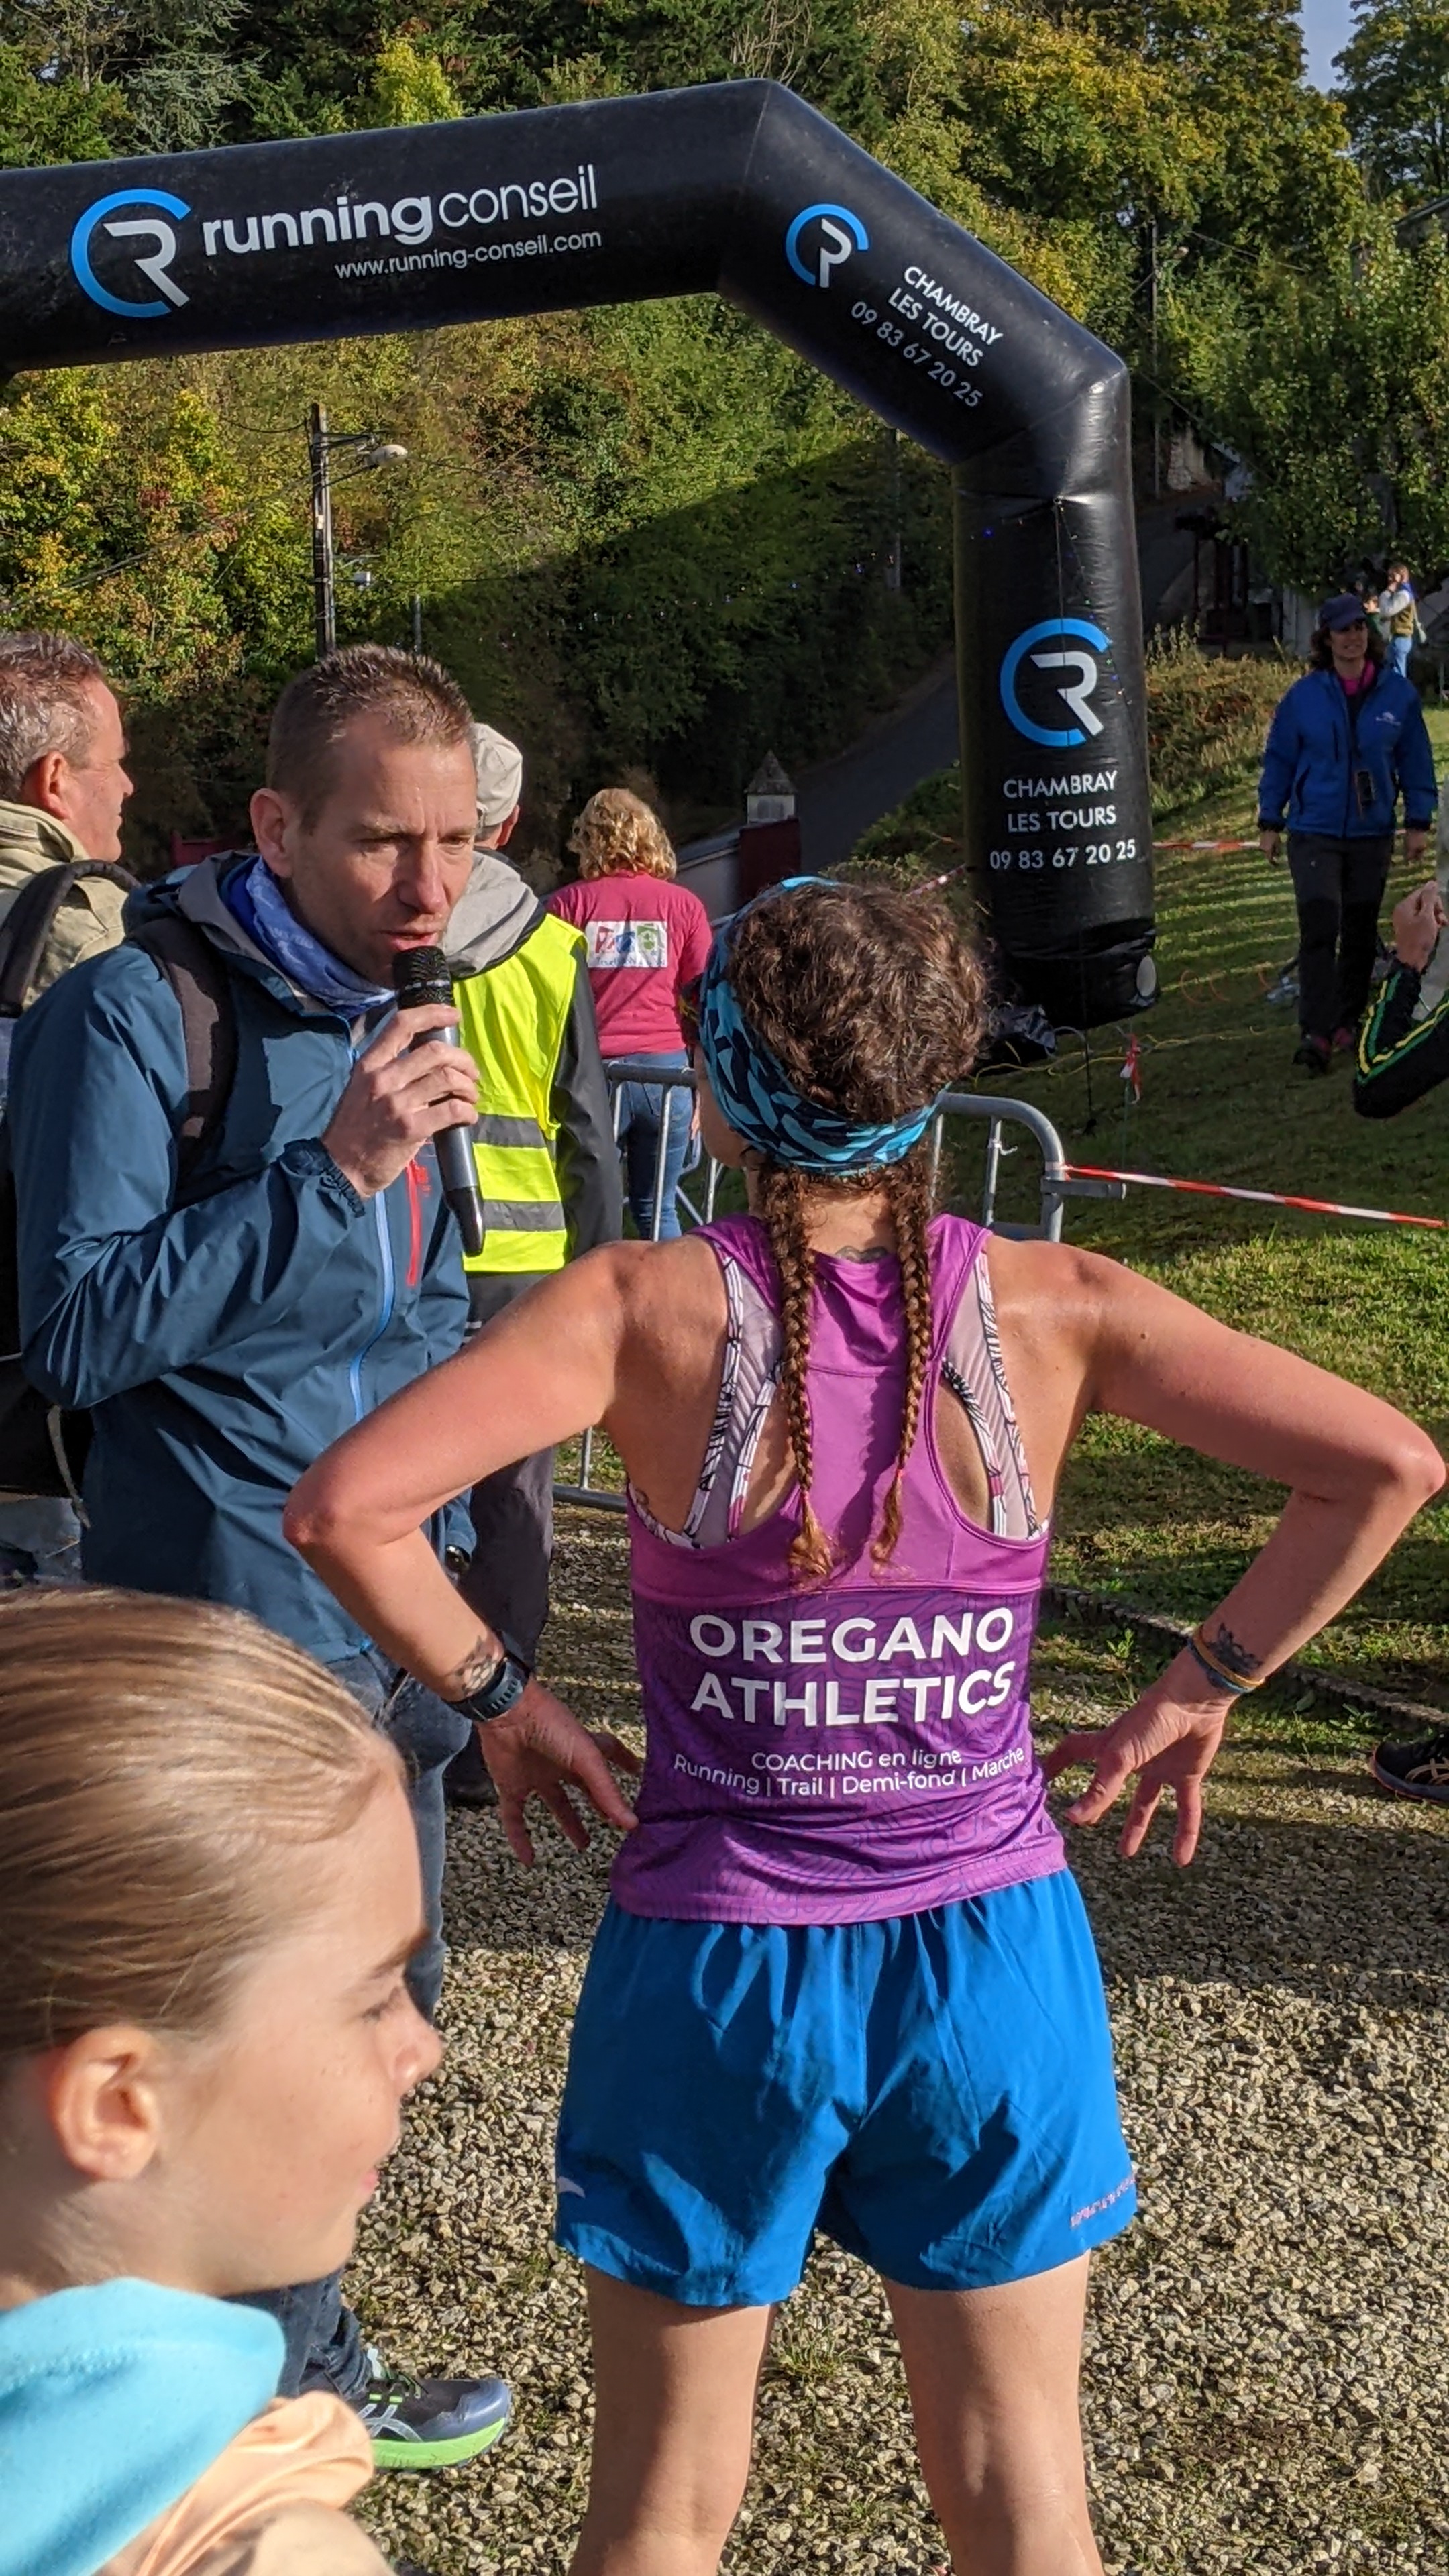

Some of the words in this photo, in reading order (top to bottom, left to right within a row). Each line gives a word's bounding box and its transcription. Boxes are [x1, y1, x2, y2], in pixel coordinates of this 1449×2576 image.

[335, 231, 602, 279] www.running-conseil.com
[888, 288, 923, 321] LES
[922, 312, 984, 367] TOURS
[904, 266, 1004, 345] CHAMBRAY
[851, 301, 877, 325] 09
[877, 321, 904, 347] 83
[903, 343, 932, 364] 67
[928, 361, 955, 387] 20
[953, 382, 983, 407] 25
[1003, 770, 1118, 798] CHAMBRAY
[1008, 812, 1040, 833] LES
[1046, 805, 1116, 830] TOURS
[989, 850, 1011, 870] 09
[1018, 850, 1044, 869] 83
[1051, 847, 1079, 868] 67
[1085, 843, 1112, 865] 20
[1116, 839, 1136, 862] 25
[689, 1607, 1014, 1664] OREGANO
[690, 1661, 1016, 1727] ATHLETICS
[673, 1753, 759, 1795] Running
[777, 1777, 823, 1796] Trail
[842, 1770, 955, 1794] Demi-fond
[971, 1747, 1025, 1781] Marche
[751, 1750, 873, 1772] COACHING
[878, 1753, 906, 1768] en
[912, 1748, 963, 1769] ligne
